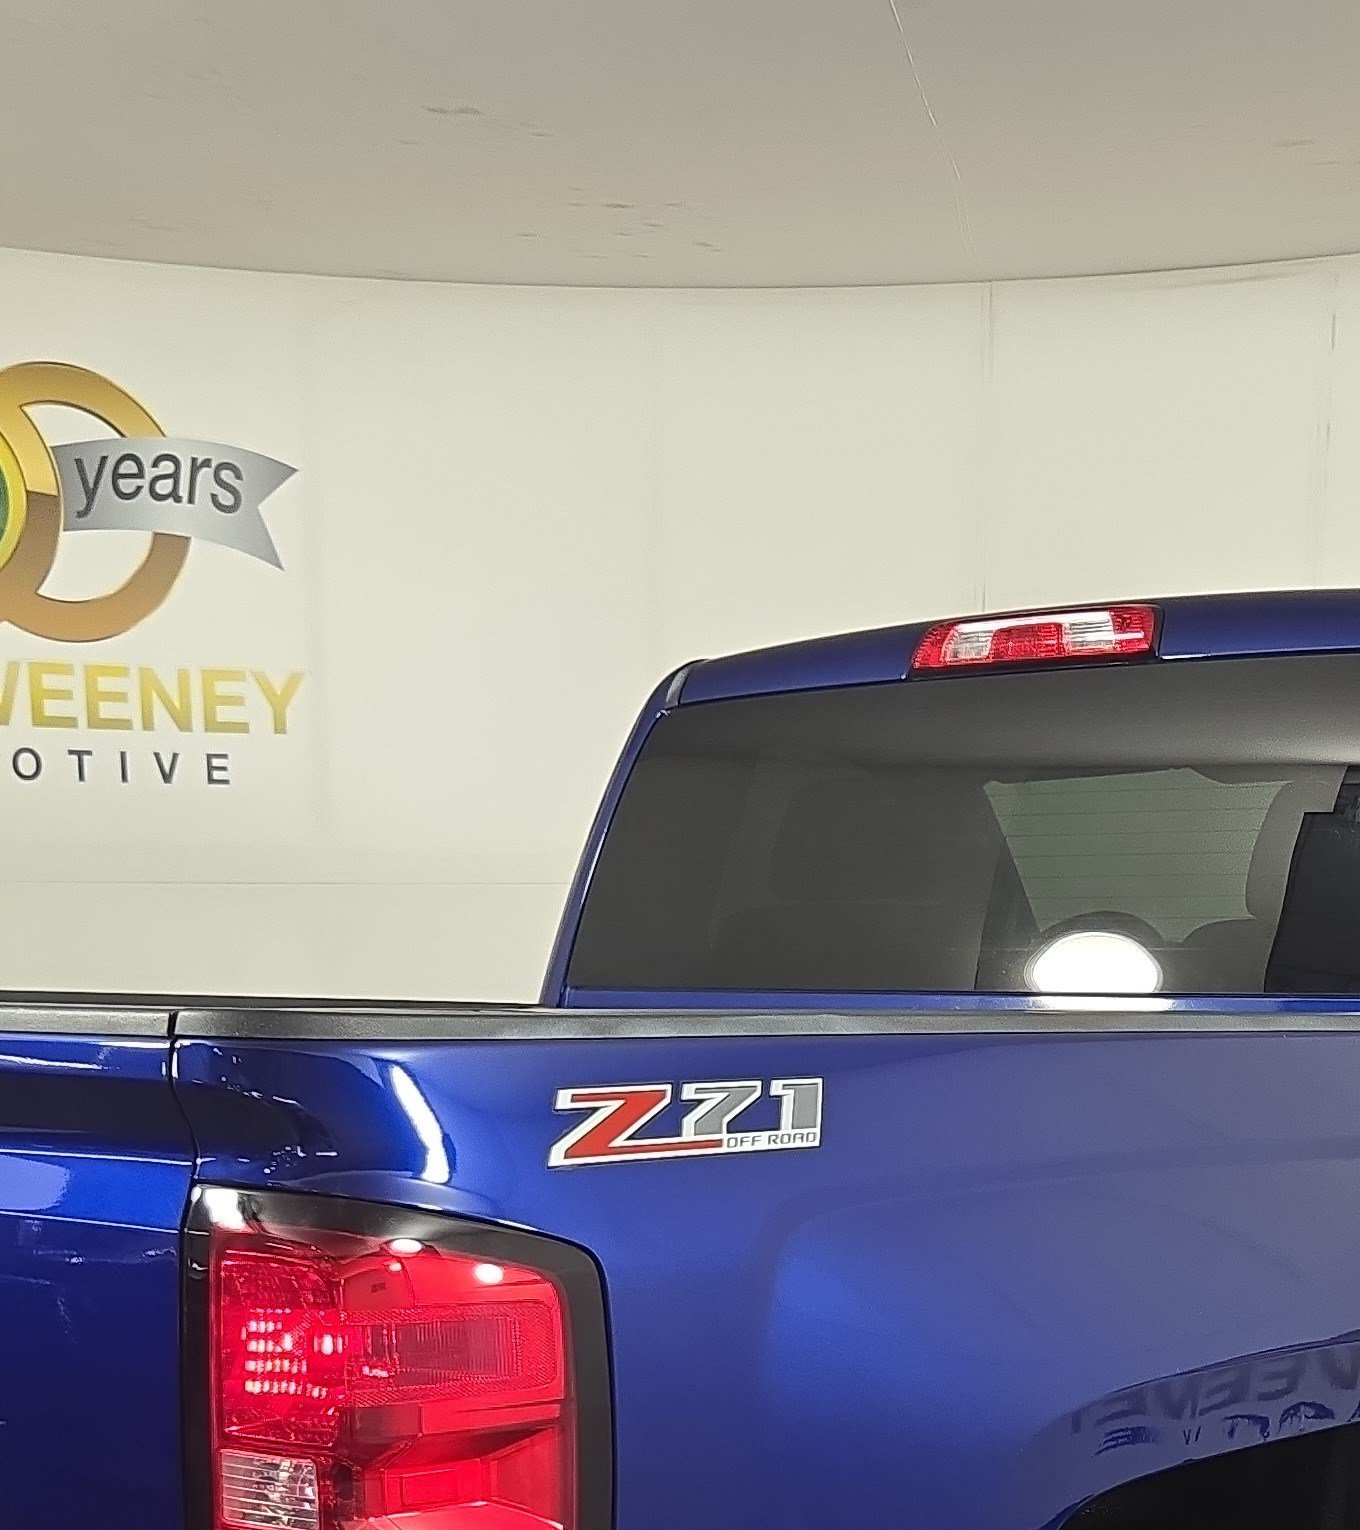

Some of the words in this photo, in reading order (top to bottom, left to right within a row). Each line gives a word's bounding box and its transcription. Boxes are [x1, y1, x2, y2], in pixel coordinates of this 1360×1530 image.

[75, 451, 243, 518] years
[547, 1077, 824, 1167] Z71
[727, 1135, 763, 1149] OFF
[768, 1132, 817, 1146] ROAD
